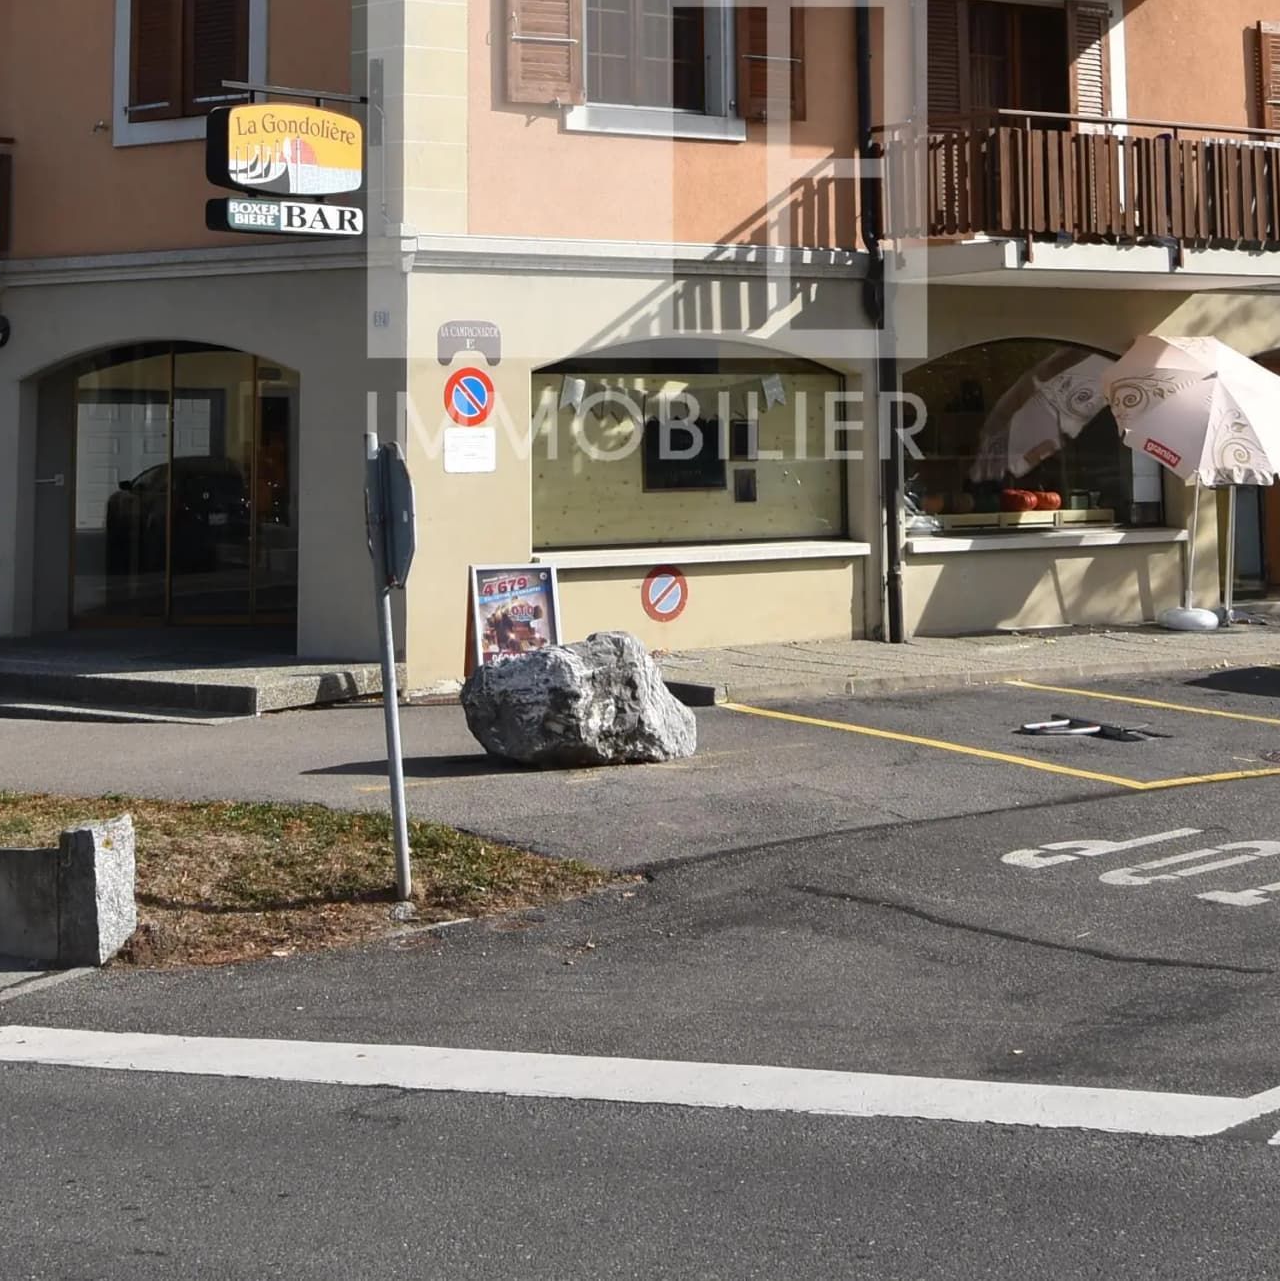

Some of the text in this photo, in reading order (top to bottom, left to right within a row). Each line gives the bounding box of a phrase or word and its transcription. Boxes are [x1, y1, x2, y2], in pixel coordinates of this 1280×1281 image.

[236, 113, 356, 145] La Gondolière
[229, 201, 280, 216] BOXER
[286, 205, 359, 232] BAR
[234, 213, 276, 226] BIERE
